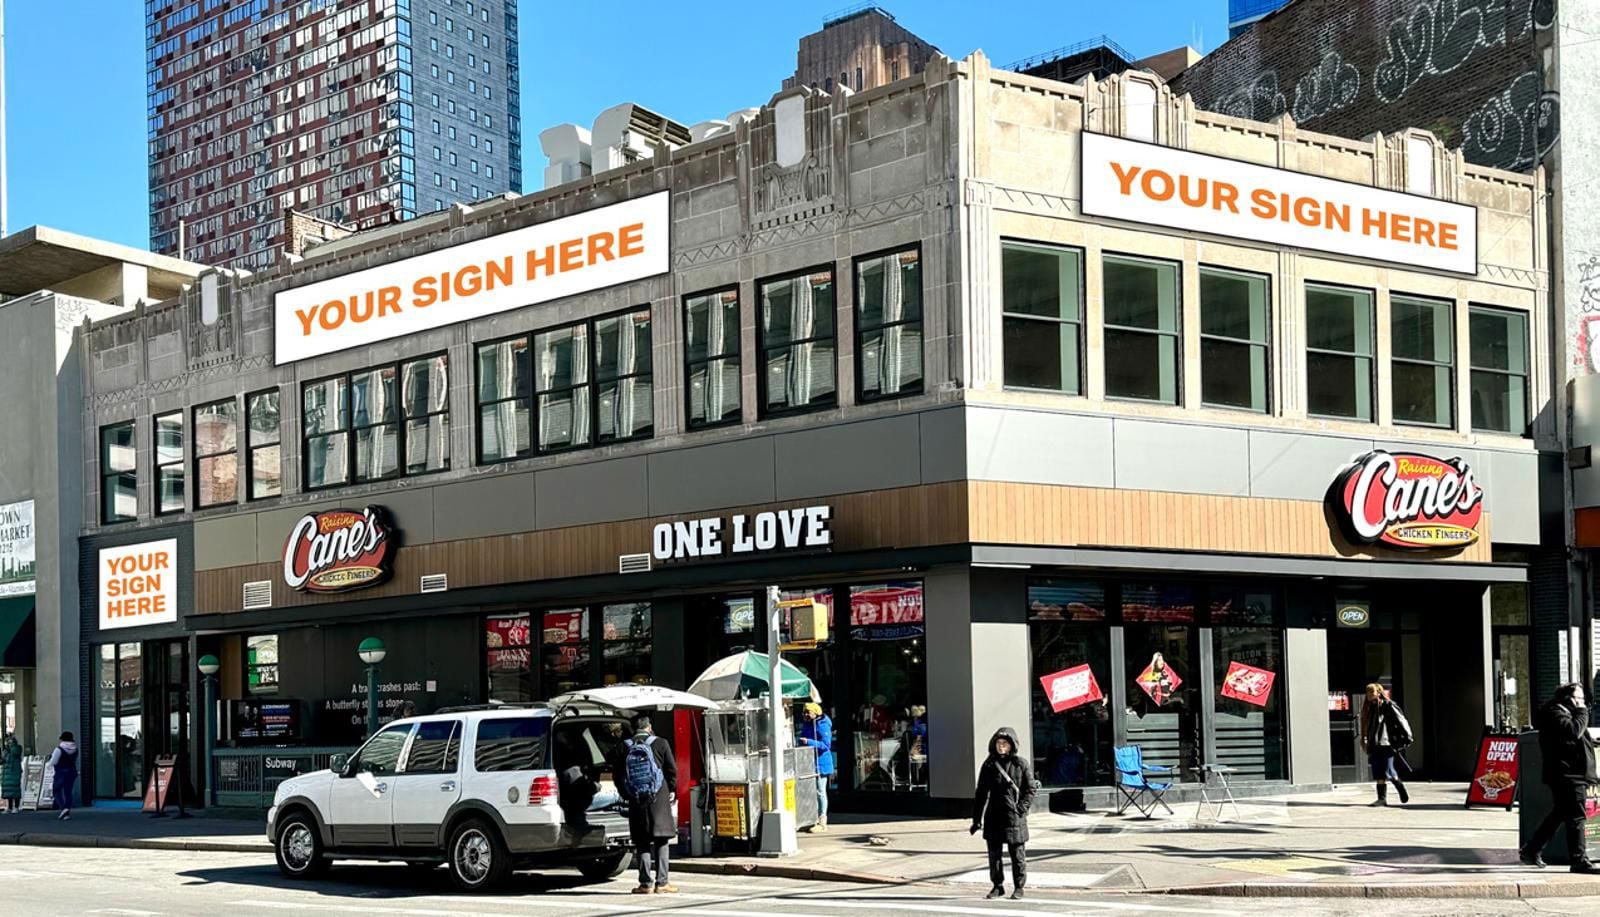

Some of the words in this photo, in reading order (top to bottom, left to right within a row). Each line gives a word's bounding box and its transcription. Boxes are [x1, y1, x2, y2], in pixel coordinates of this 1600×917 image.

[1111, 162, 1239, 214] YOUR
[1251, 188, 1351, 232] SIGN
[1362, 208, 1458, 250] HERE
[295, 286, 401, 336] YOUR
[412, 255, 514, 308] SIGN
[526, 223, 645, 281] HERE
[1398, 459, 1444, 479] Raising
[1352, 453, 1482, 538] Cane's
[320, 514, 356, 531] Raising
[654, 517, 721, 559] ONE
[732, 506, 829, 552] LOVE
[1397, 527, 1433, 539] CHICKEN
[1435, 529, 1471, 540] FINGERS
[284, 508, 383, 588] Cane's
[107, 551, 168, 575] YOUR
[107, 574, 161, 597] SIGN
[107, 594, 165, 618] HERE
[735, 609, 754, 621] OPE
[1342, 611, 1365, 621] OPEN
[352, 684, 357, 693] A
[403, 682, 421, 693] past:
[325, 701, 331, 710] A
[332, 700, 360, 711] butterfly
[1489, 741, 1518, 752] NOW
[265, 757, 297, 771] Subway
[1486, 751, 1515, 762] OPEN
